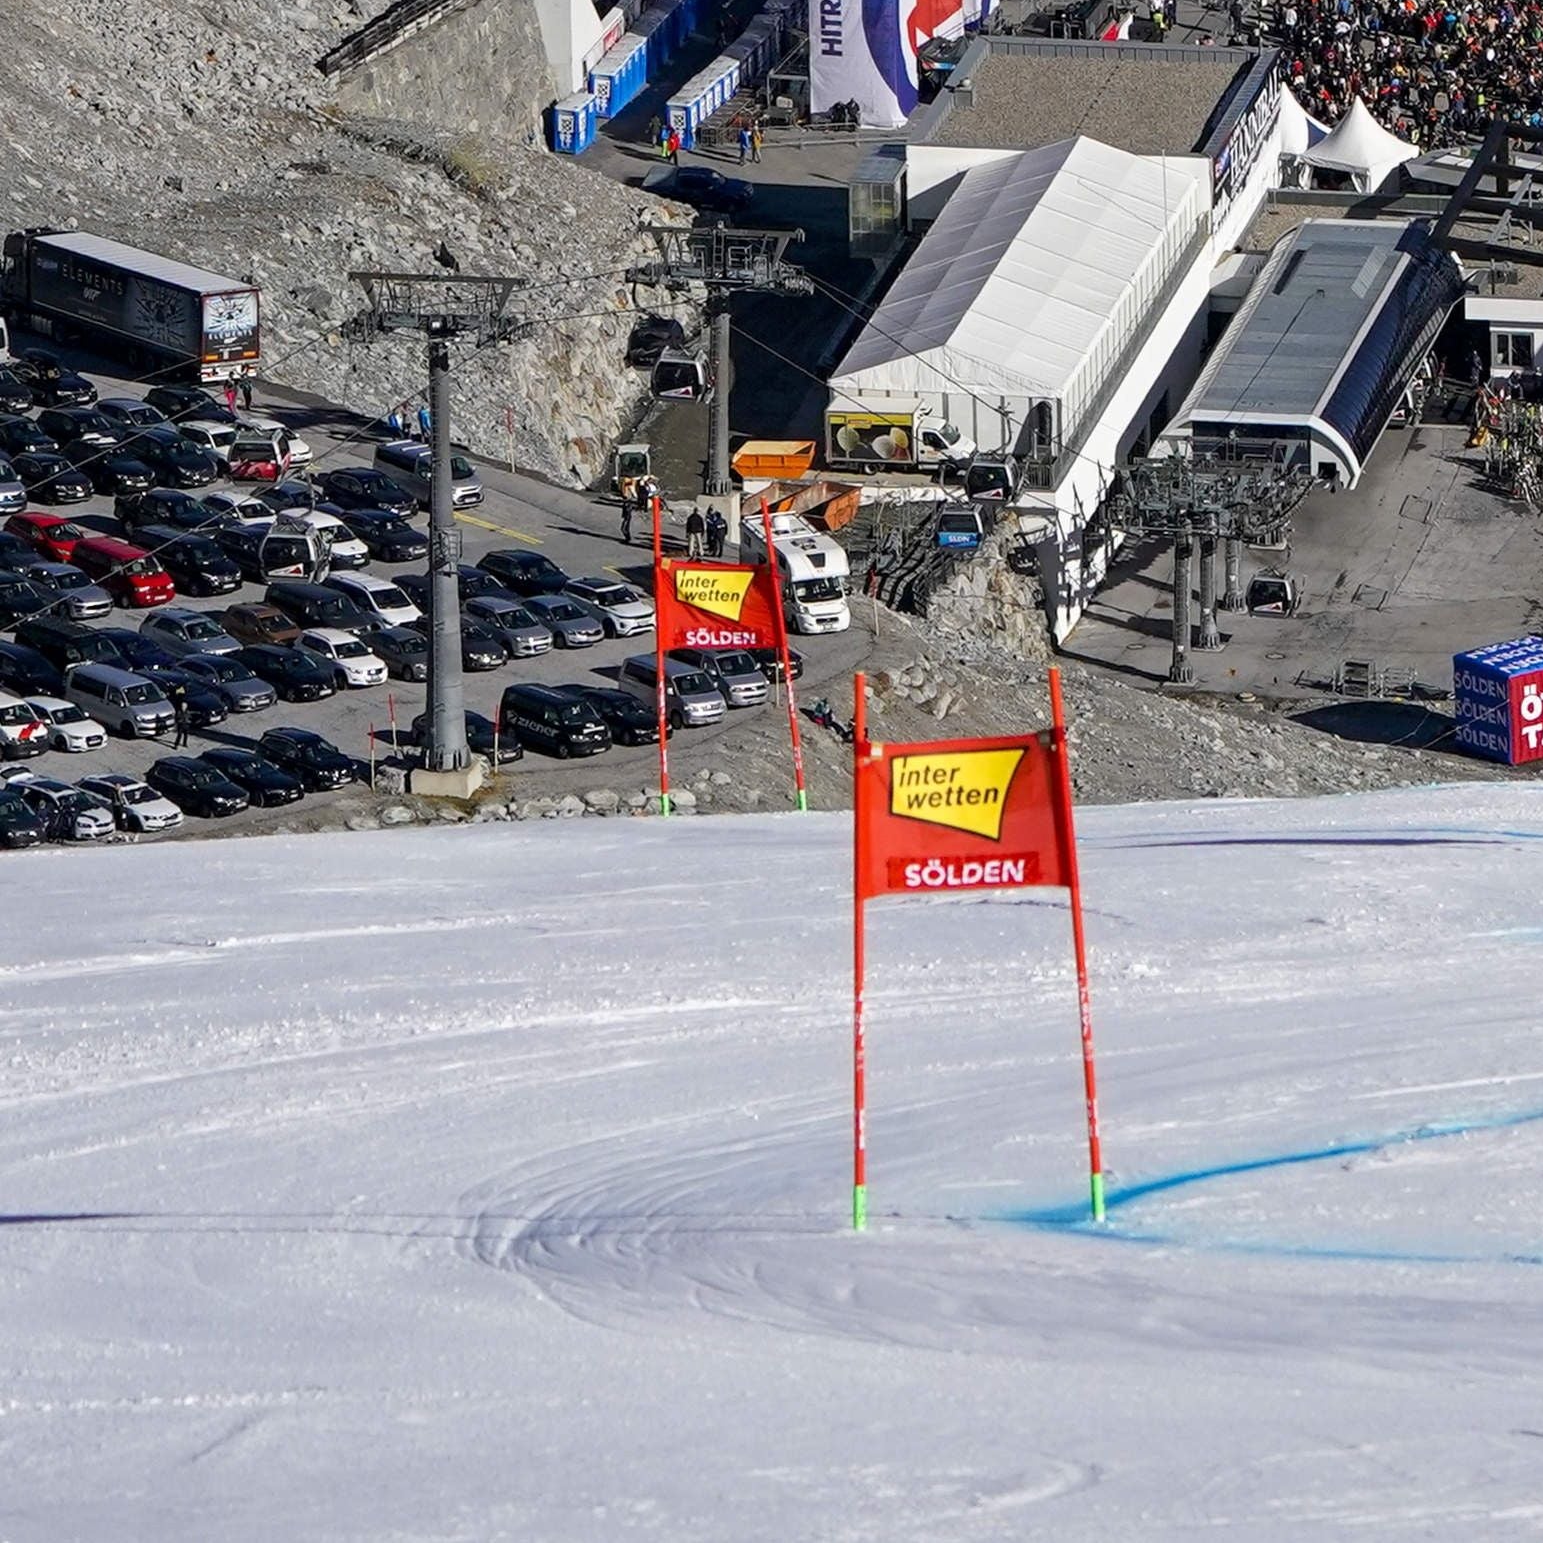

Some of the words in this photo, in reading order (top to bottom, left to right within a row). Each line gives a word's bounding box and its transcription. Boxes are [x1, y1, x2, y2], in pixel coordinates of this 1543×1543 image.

[62, 263, 124, 296] ELEMENTS
[680, 570, 720, 588] inter
[684, 589, 741, 603] wetten
[686, 627, 757, 646] SÖLDEN
[1454, 669, 1507, 699] SÖLDEN
[1454, 697, 1508, 728] SÖLDEN
[1454, 723, 1509, 754] SÖLDEN
[900, 758, 961, 788] inter
[907, 786, 999, 810] wetten
[904, 859, 1026, 888] SÖLDEN
